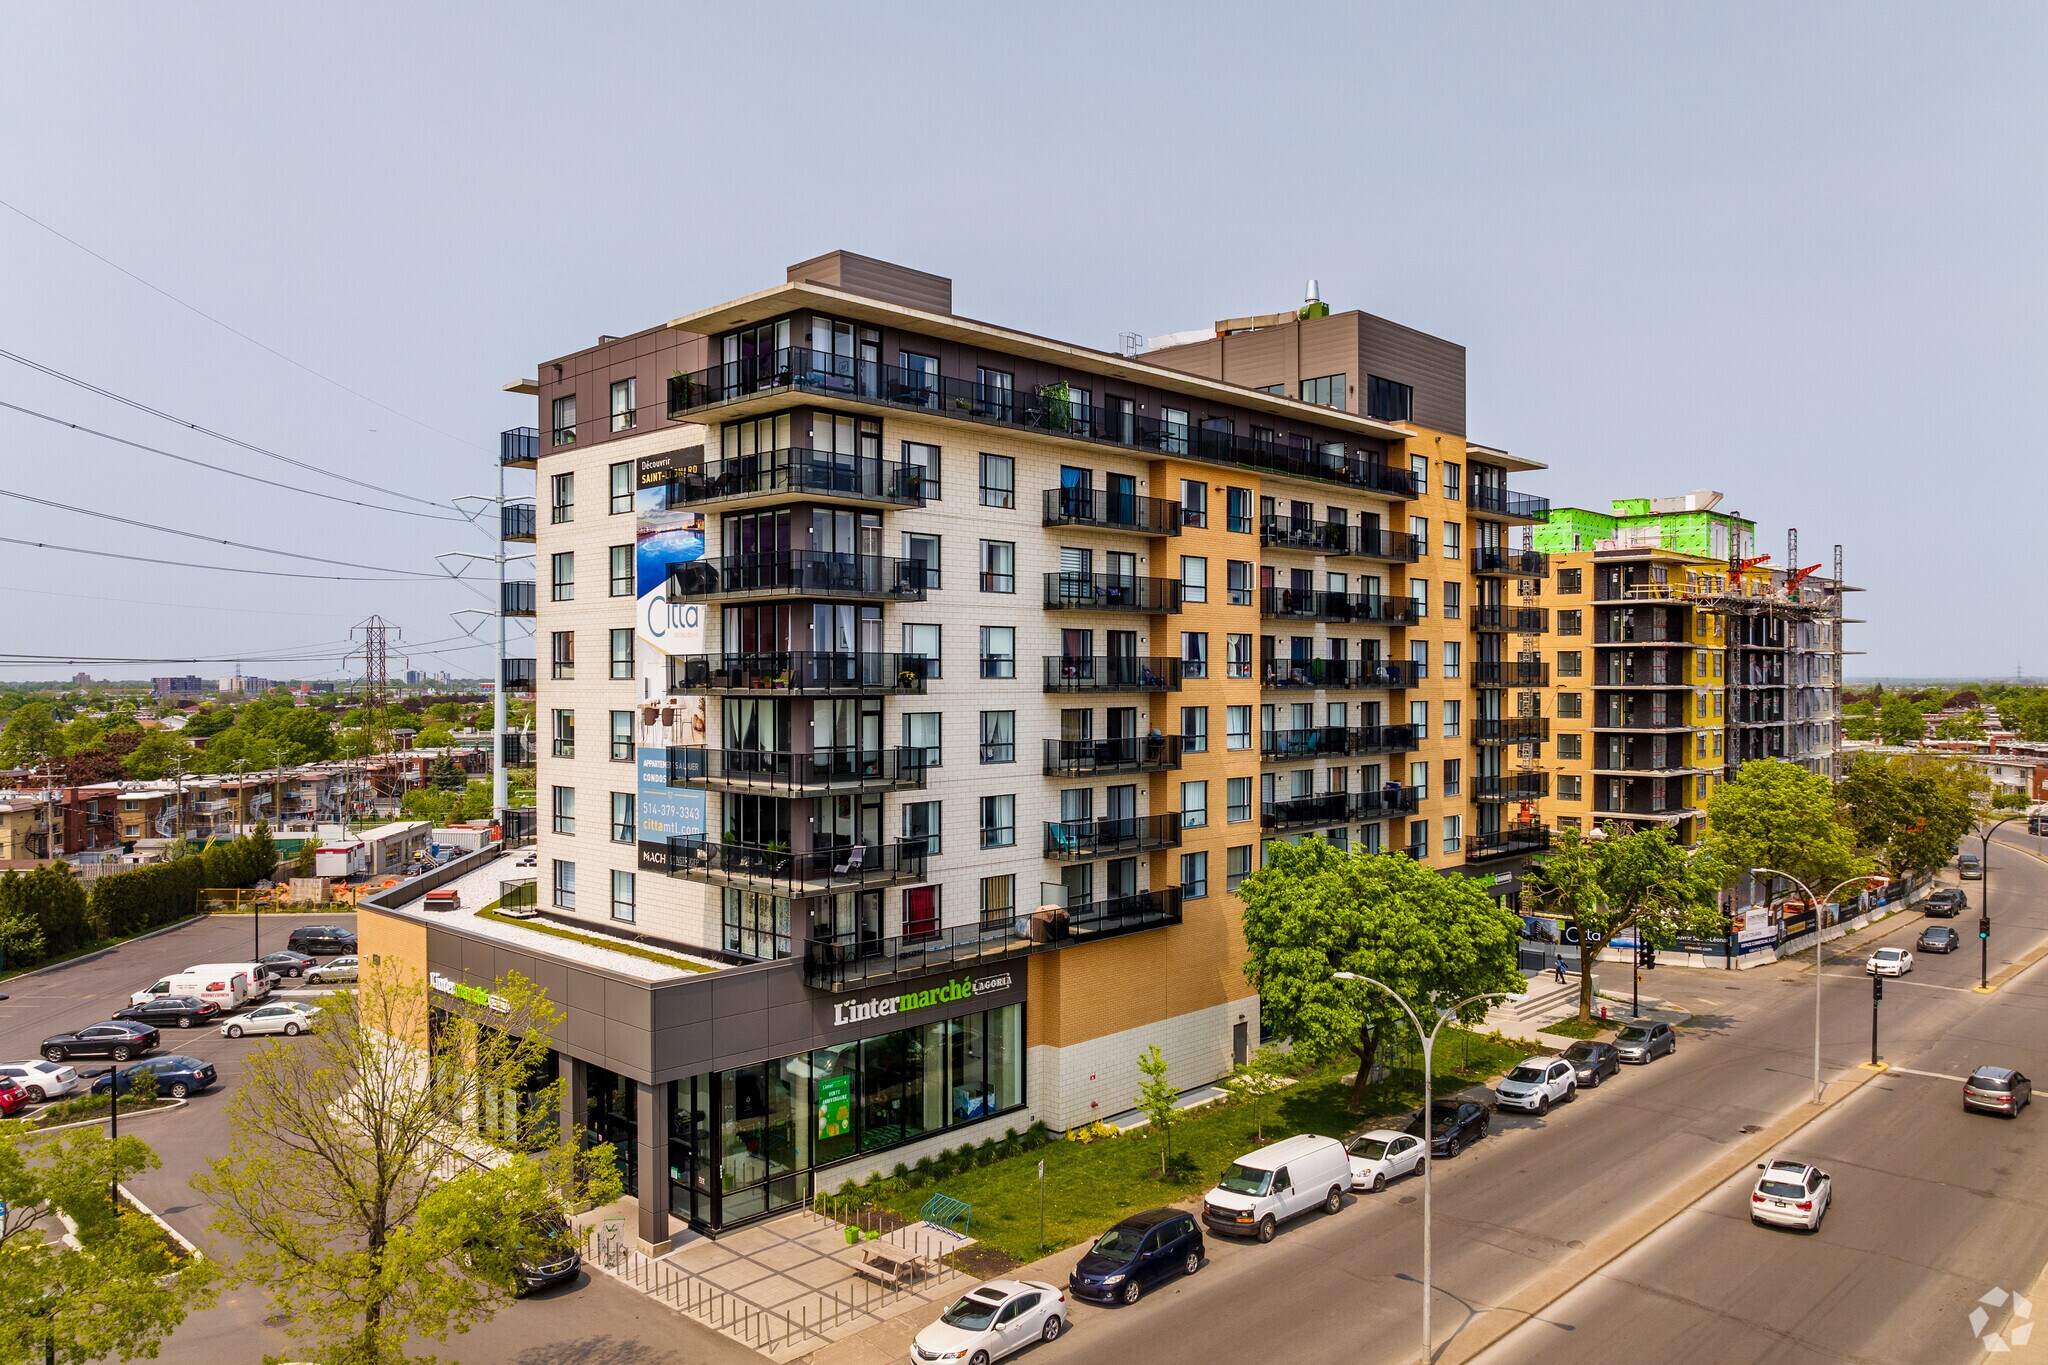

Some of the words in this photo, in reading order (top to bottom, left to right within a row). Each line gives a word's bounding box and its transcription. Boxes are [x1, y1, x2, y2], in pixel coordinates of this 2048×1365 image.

[641, 457, 671, 470] Découvrir
[641, 464, 698, 484] SAINT-LONRD
[648, 595, 698, 638] Citta
[643, 759, 678, 770] APPARTEMES
[683, 762, 699, 771] LUER
[643, 773, 667, 783] CONDOS
[643, 802, 700, 820] 514-379-3343
[643, 818, 700, 835] cittamtl.com
[643, 850, 666, 864] MACH
[1565, 926, 1601, 943] Cta
[833, 975, 972, 1026] L'intermarché
[972, 975, 1012, 993] LAGORIA
